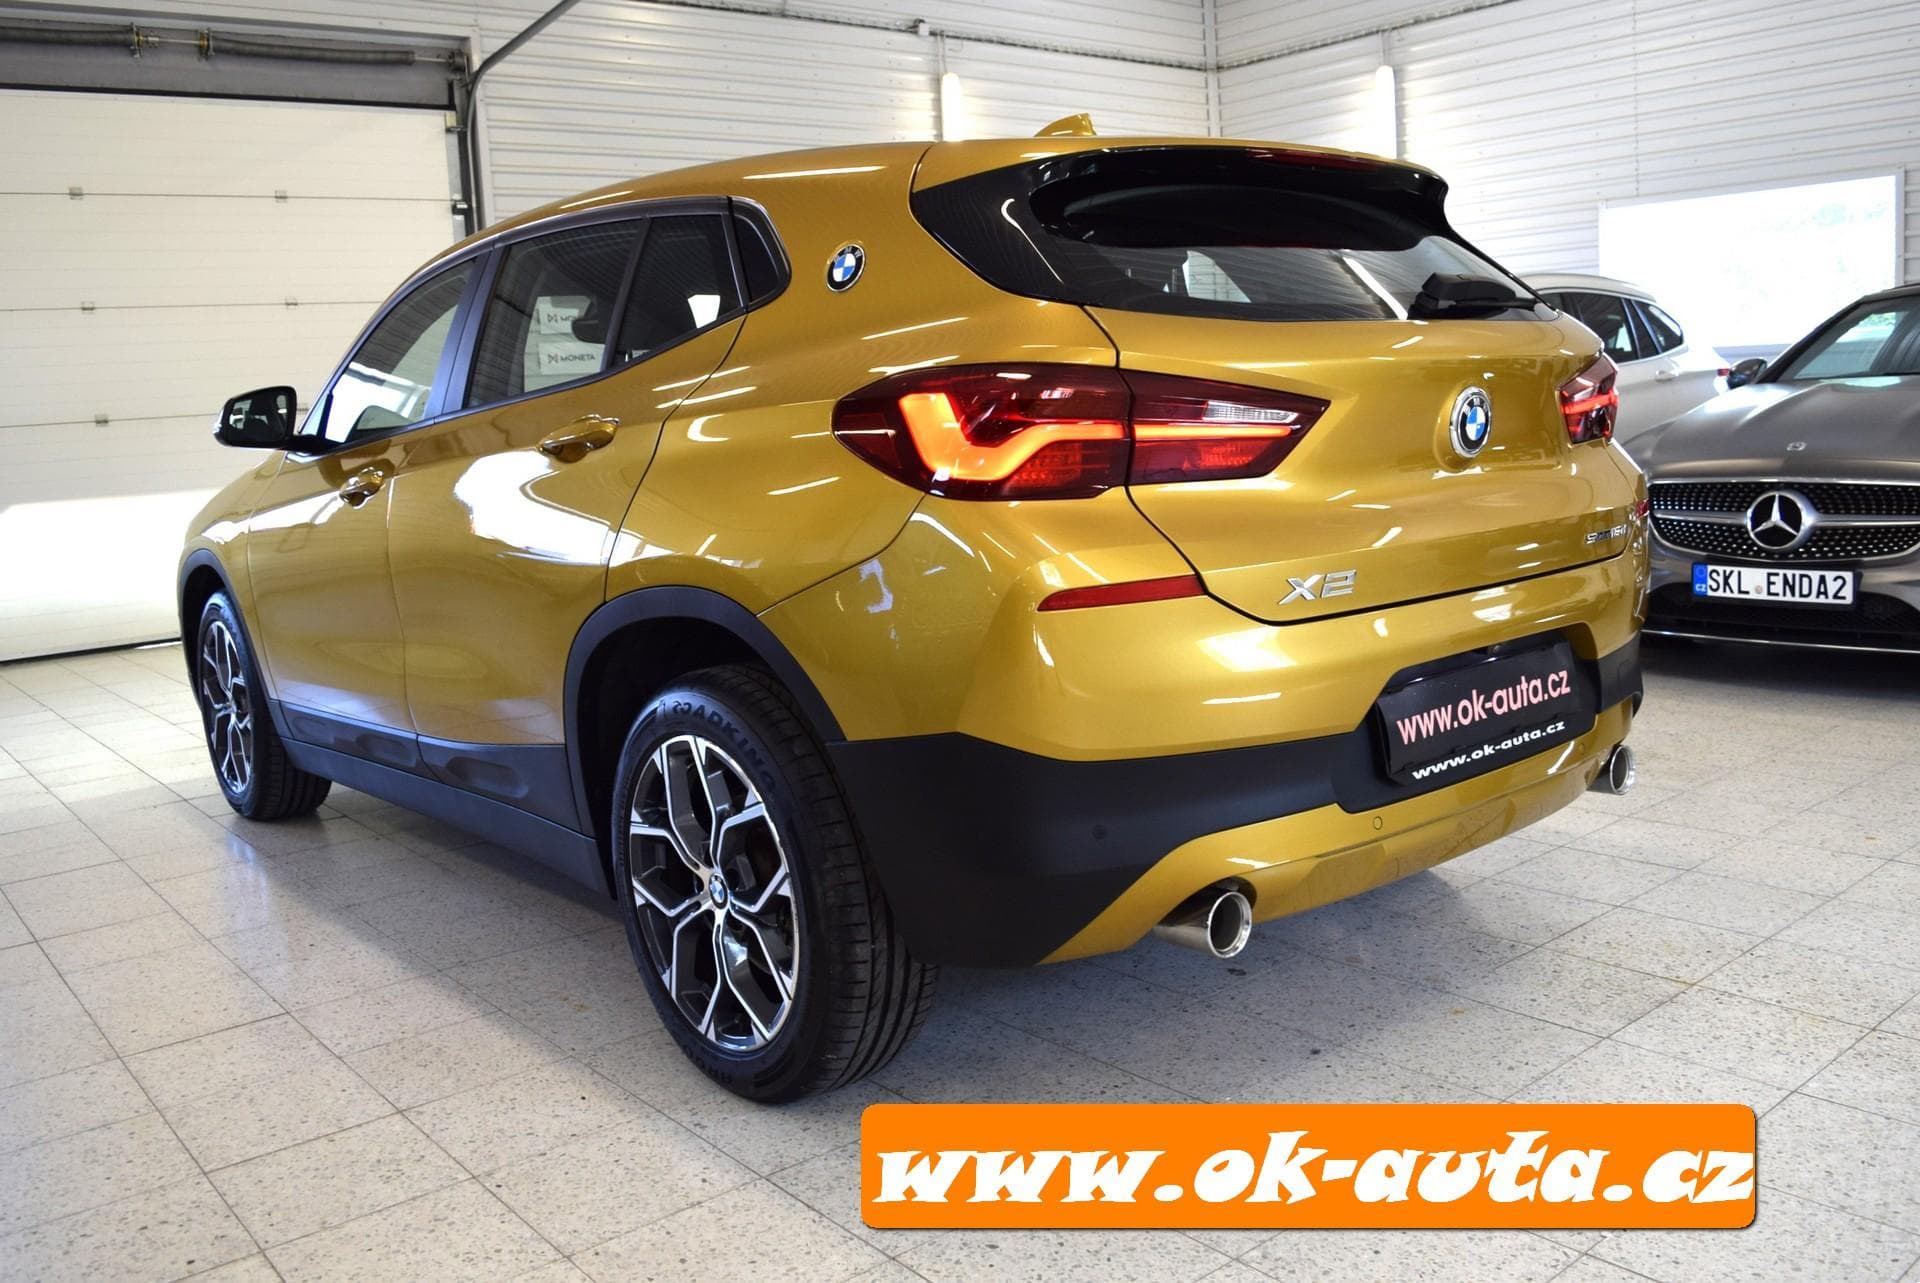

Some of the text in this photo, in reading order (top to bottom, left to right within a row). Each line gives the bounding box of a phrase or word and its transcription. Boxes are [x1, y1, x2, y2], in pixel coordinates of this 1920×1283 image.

[1277, 569, 1357, 605] X2
[1695, 583, 1706, 592] CZ
[1708, 569, 1847, 600] SKL ENDA2
[1396, 670, 1571, 745] www.ok-auta.cz
[1412, 721, 1565, 779] www.ok-auta.cz
